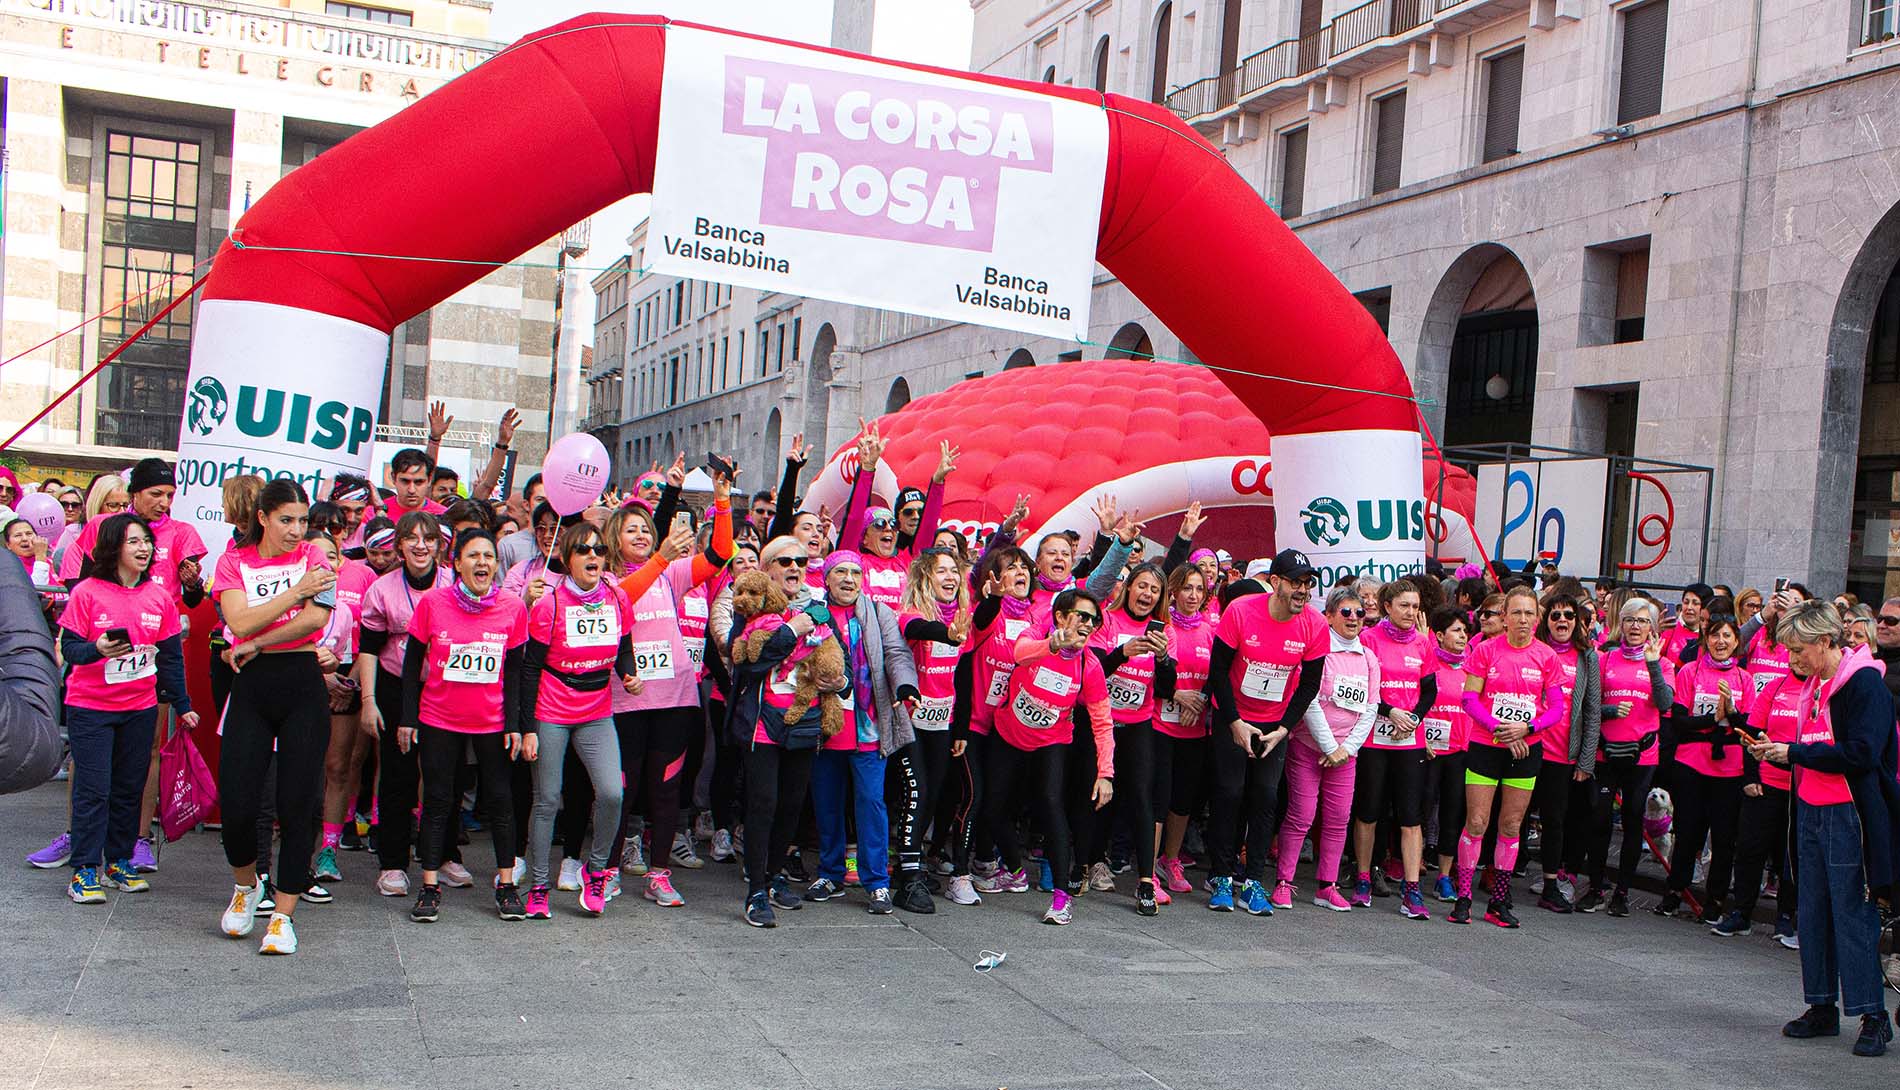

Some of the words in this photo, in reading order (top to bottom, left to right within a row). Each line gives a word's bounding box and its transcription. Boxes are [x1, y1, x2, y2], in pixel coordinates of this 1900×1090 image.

[742, 75, 821, 135] LA
[834, 90, 1034, 161] CORSA
[694, 216, 765, 247] Banca
[663, 235, 790, 274] Valsabbina
[983, 266, 1049, 295] Banca
[955, 284, 1071, 321] Valsabbina
[235, 384, 373, 456] UISP
[578, 463, 599, 478] CFP
[38, 516, 56, 527] CFP
[257, 578, 291, 597] 671
[872, 594, 898, 603] CORSA
[577, 618, 608, 635] 675
[116, 653, 148, 672] 714
[448, 654, 497, 672] 2010
[561, 659, 573, 669] LA
[636, 653, 669, 670] 912
[927, 665, 950, 674] CORSA
[1757, 658, 1779, 668] CORSA
[1262, 679, 1270, 691] 1
[1381, 680, 1404, 689] CORSA
[1610, 689, 1631, 697] CORSA
[1106, 683, 1140, 706] 3592
[1337, 685, 1365, 703] 5660
[917, 707, 950, 721] 3080
[1016, 697, 1052, 727] 3505
[1495, 706, 1532, 723] 4259
[902, 757, 919, 810] UNDER
